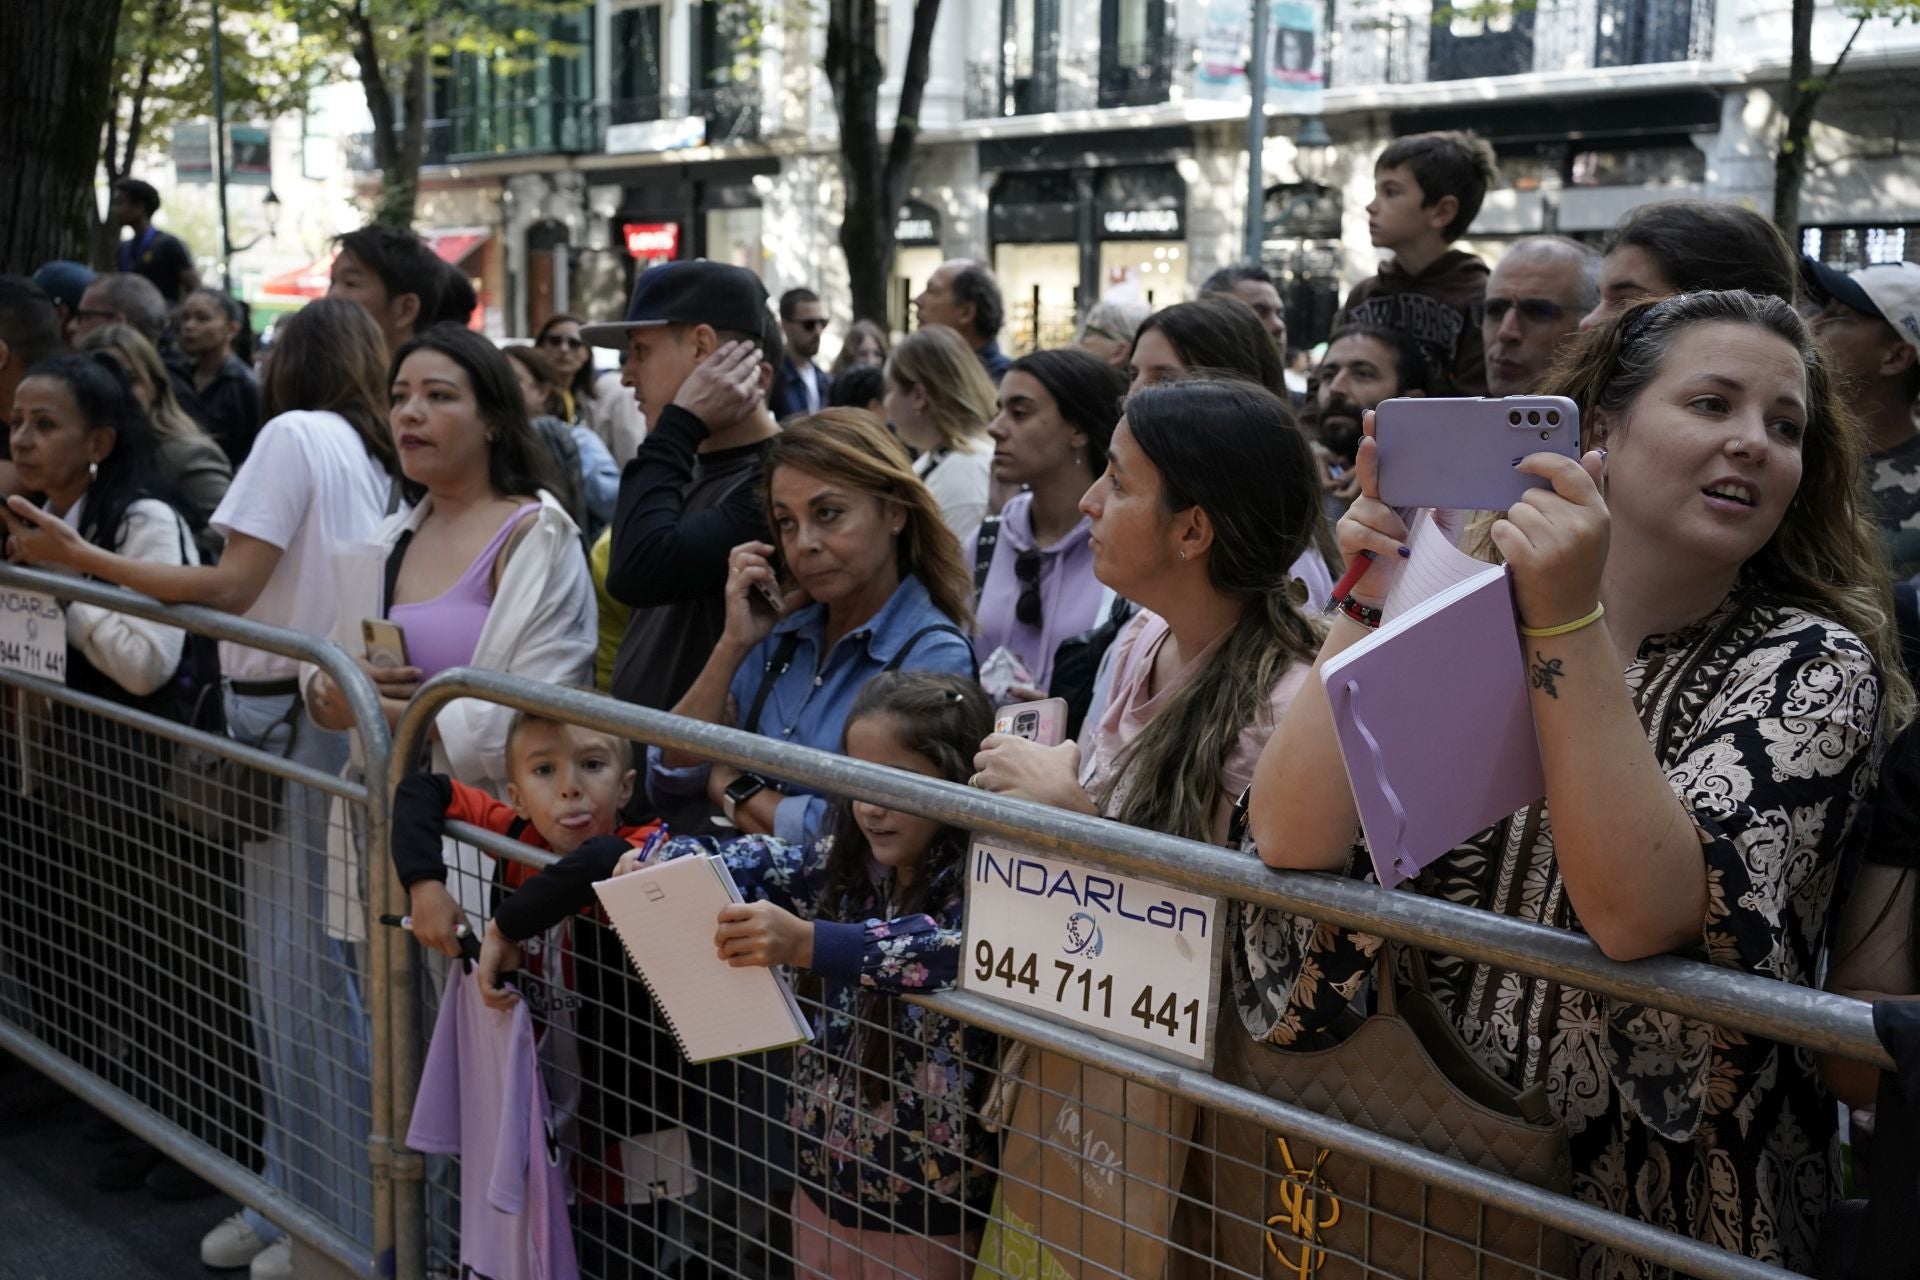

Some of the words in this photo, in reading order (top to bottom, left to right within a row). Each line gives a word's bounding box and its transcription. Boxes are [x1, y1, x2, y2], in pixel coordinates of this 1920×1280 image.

[976, 849, 1208, 938] INDARLan
[974, 939, 1040, 995] 944
[1054, 959, 1114, 1019] 711
[1130, 984, 1201, 1045] 441
